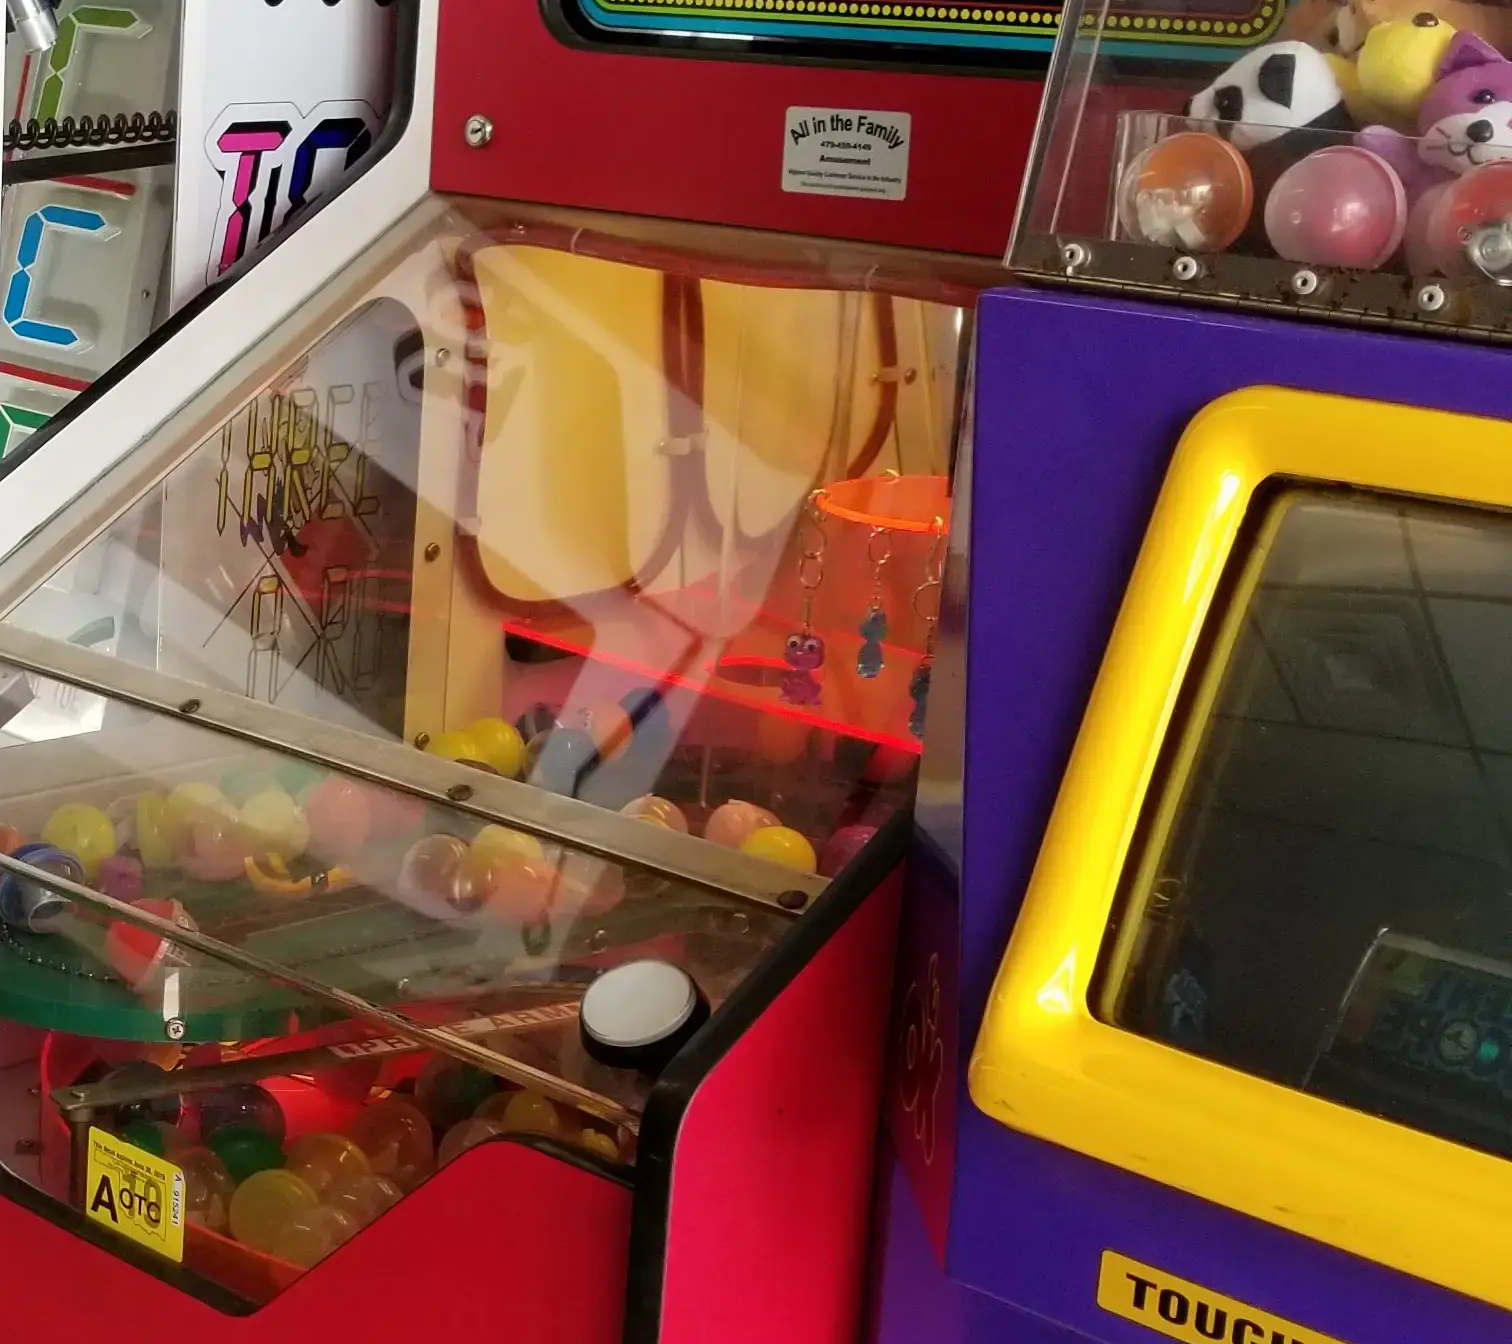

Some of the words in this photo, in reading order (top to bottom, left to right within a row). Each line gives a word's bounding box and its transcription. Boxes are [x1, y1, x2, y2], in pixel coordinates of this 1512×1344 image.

[790, 120, 810, 146] All
[812, 117, 827, 134] in
[830, 114, 853, 132] the
[857, 115, 904, 150] Family
[90, 1173, 119, 1224] A
[119, 1187, 162, 1224] OTC
